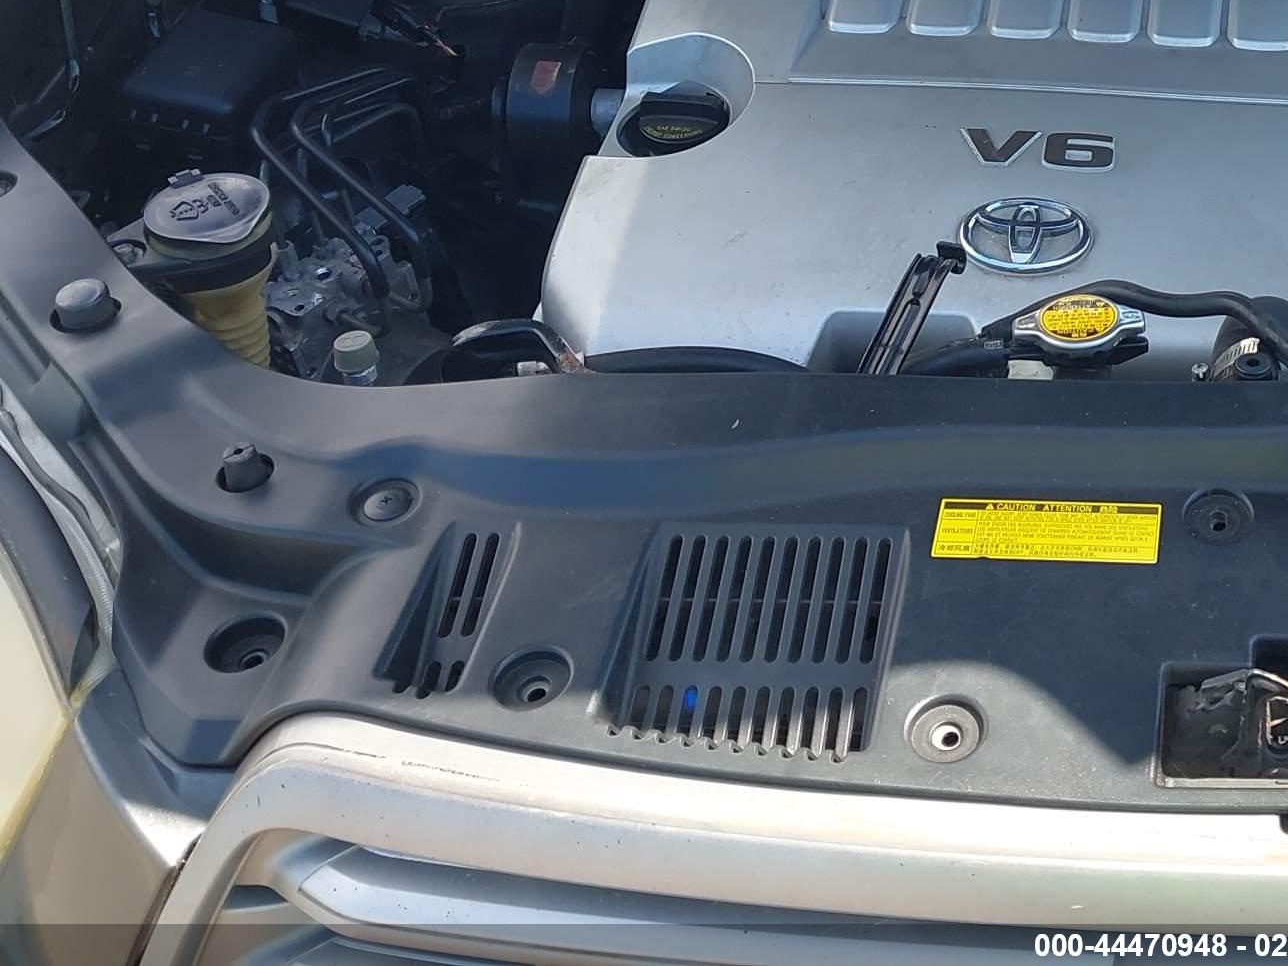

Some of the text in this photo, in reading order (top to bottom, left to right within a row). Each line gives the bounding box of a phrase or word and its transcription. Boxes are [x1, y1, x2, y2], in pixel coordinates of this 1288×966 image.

[960, 127, 1116, 173] V6
[996, 503, 1036, 511] CAUTION
[1042, 505, 1093, 513] ATTENTION
